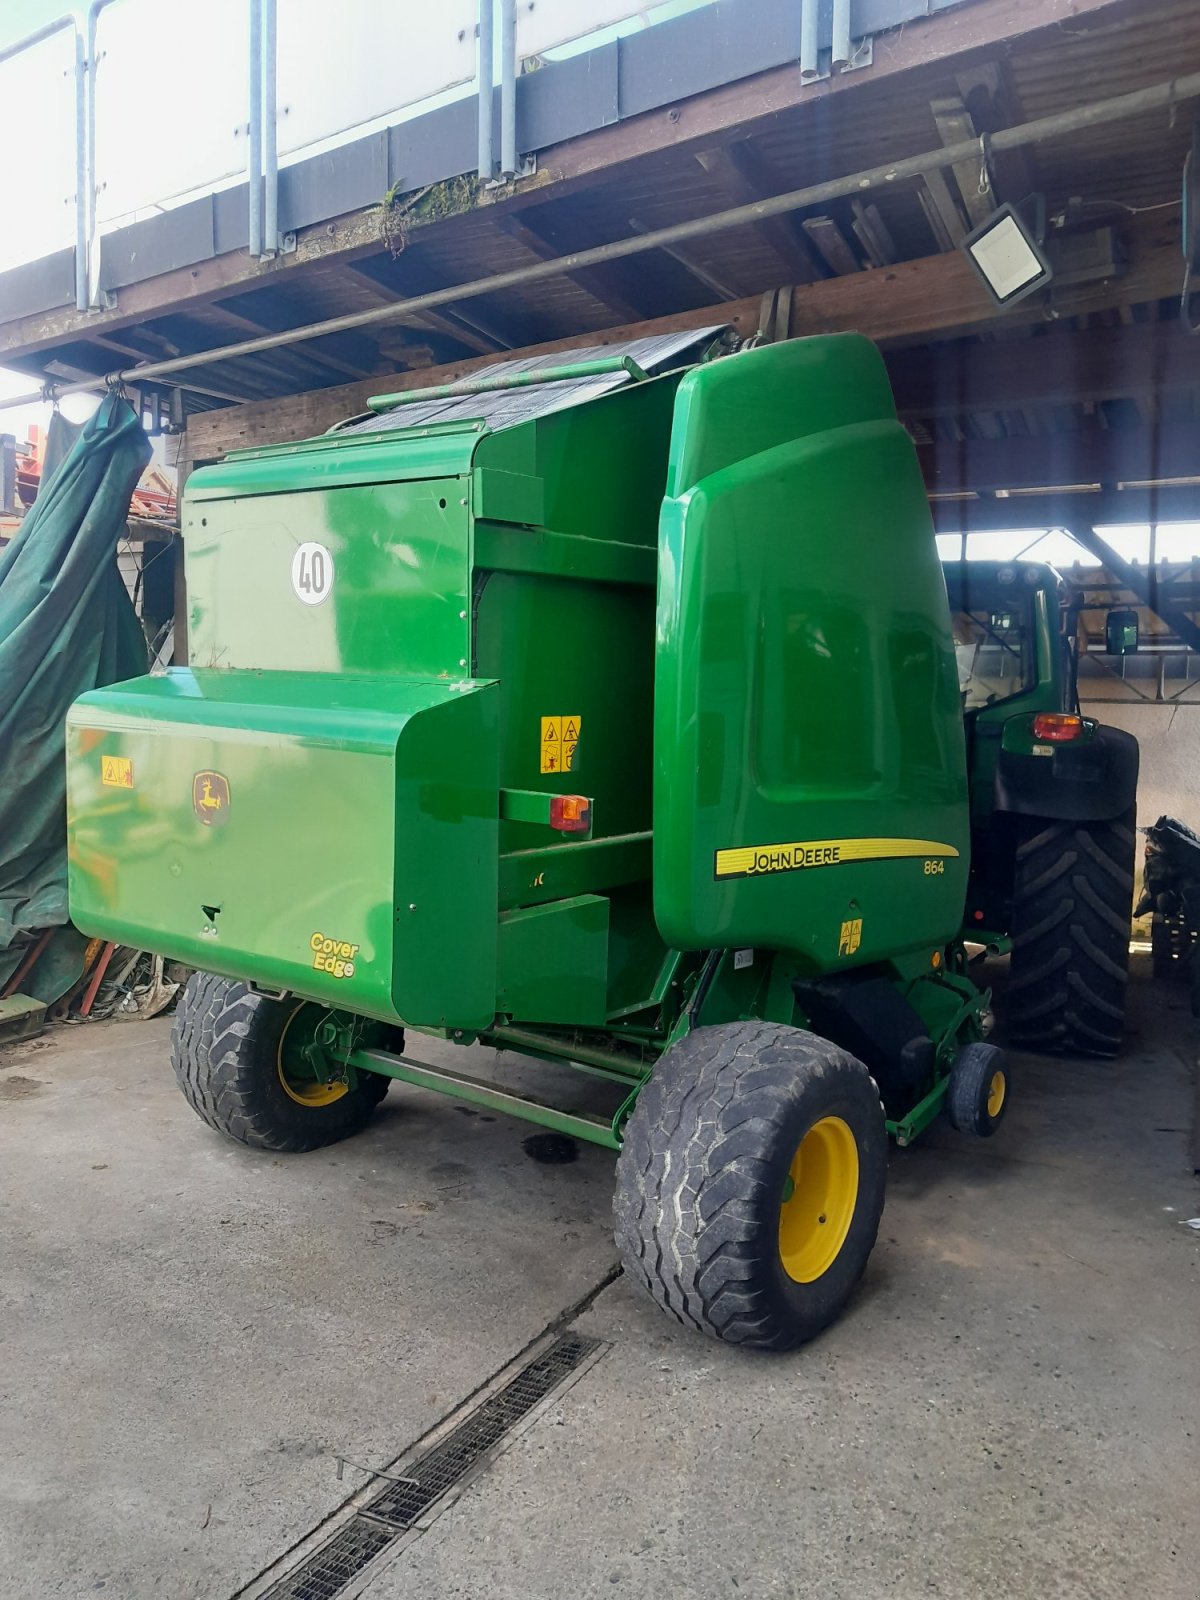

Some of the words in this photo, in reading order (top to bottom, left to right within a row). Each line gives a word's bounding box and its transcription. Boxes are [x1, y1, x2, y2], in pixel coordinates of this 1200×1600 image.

[298, 550, 325, 594] 40
[747, 852, 791, 871] JOHN
[793, 847, 841, 865] DEERE
[924, 860, 945, 875] 864
[310, 931, 360, 960] Cover
[313, 951, 355, 978] Edge
